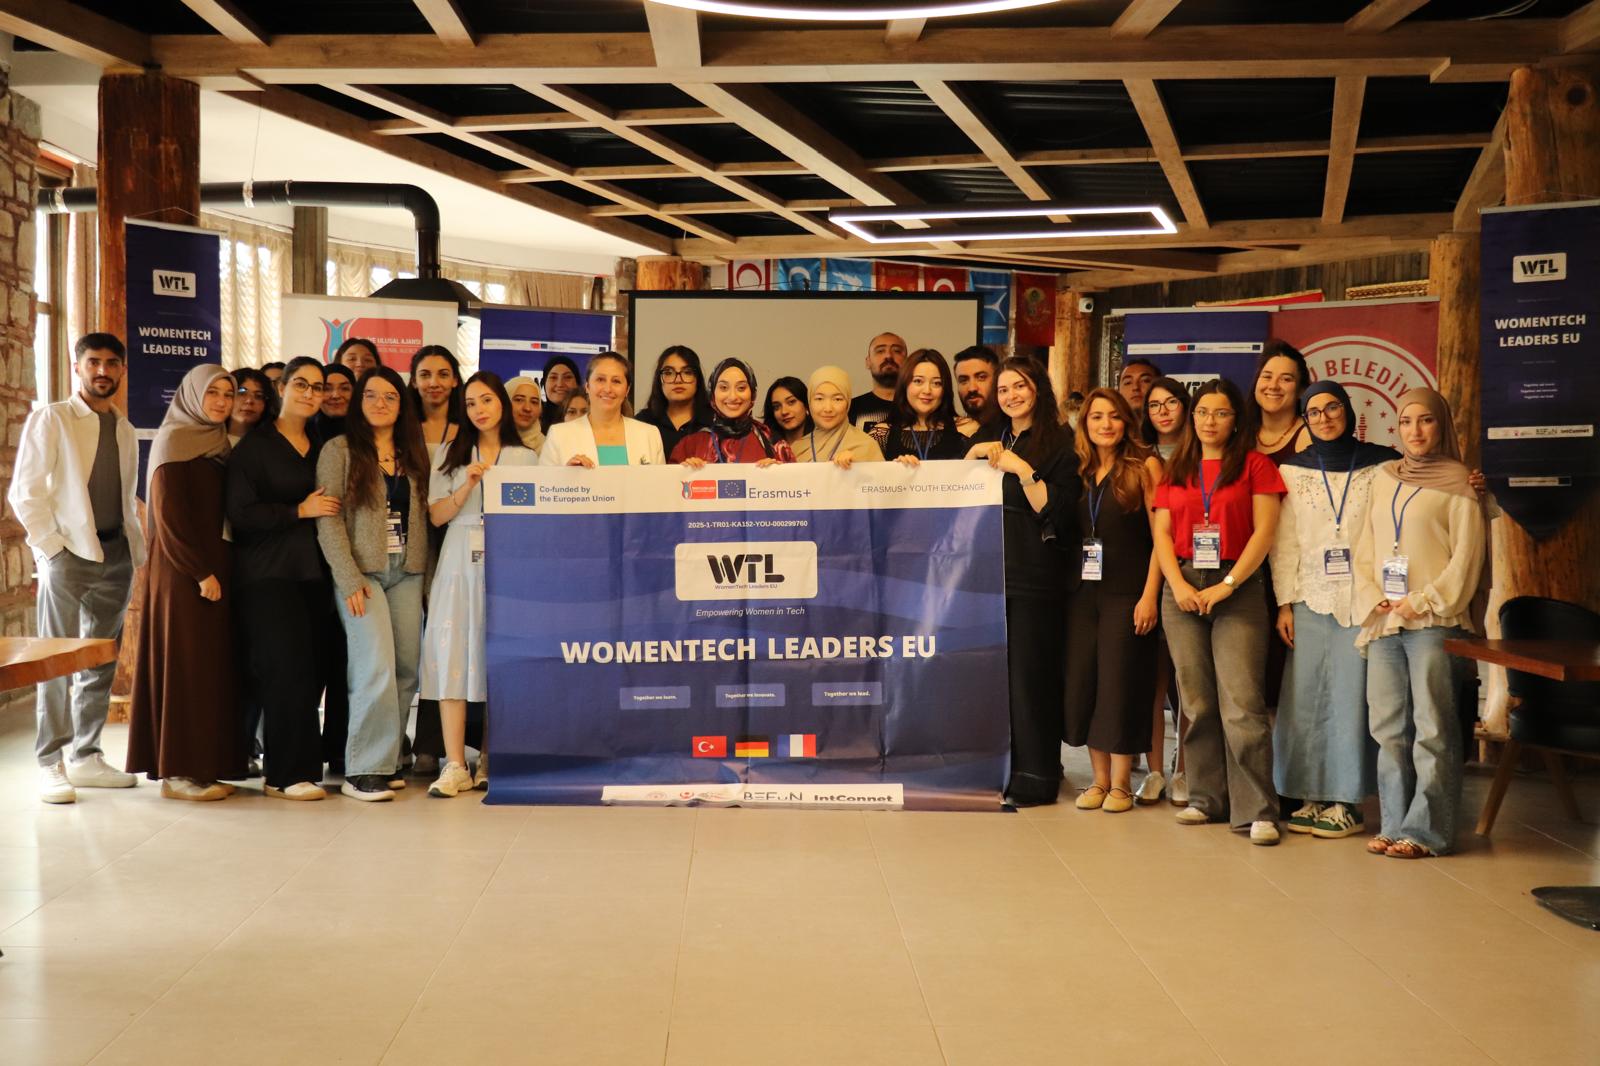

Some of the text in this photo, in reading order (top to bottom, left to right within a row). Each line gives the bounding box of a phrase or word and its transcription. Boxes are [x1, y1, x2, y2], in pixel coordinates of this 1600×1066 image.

[1519, 259, 1559, 275] WTL
[158, 274, 190, 291] WTL
[1494, 313, 1586, 330] WOMENTECH
[138, 326, 212, 342] WOMENTECH
[1499, 333, 1581, 348] LEADERS EU
[142, 343, 208, 357] LEADERS EU
[539, 485, 591, 495] Co-funded by
[749, 487, 812, 499] Erasmus+
[861, 483, 985, 494] ERASMUS+ YOUTH EXCHANGE
[539, 494, 616, 504] the European Union
[706, 553, 786, 584] WTL
[695, 606, 805, 619] Empowering Women in Tech
[560, 635, 937, 664] WOMENTECH LEADERS EU
